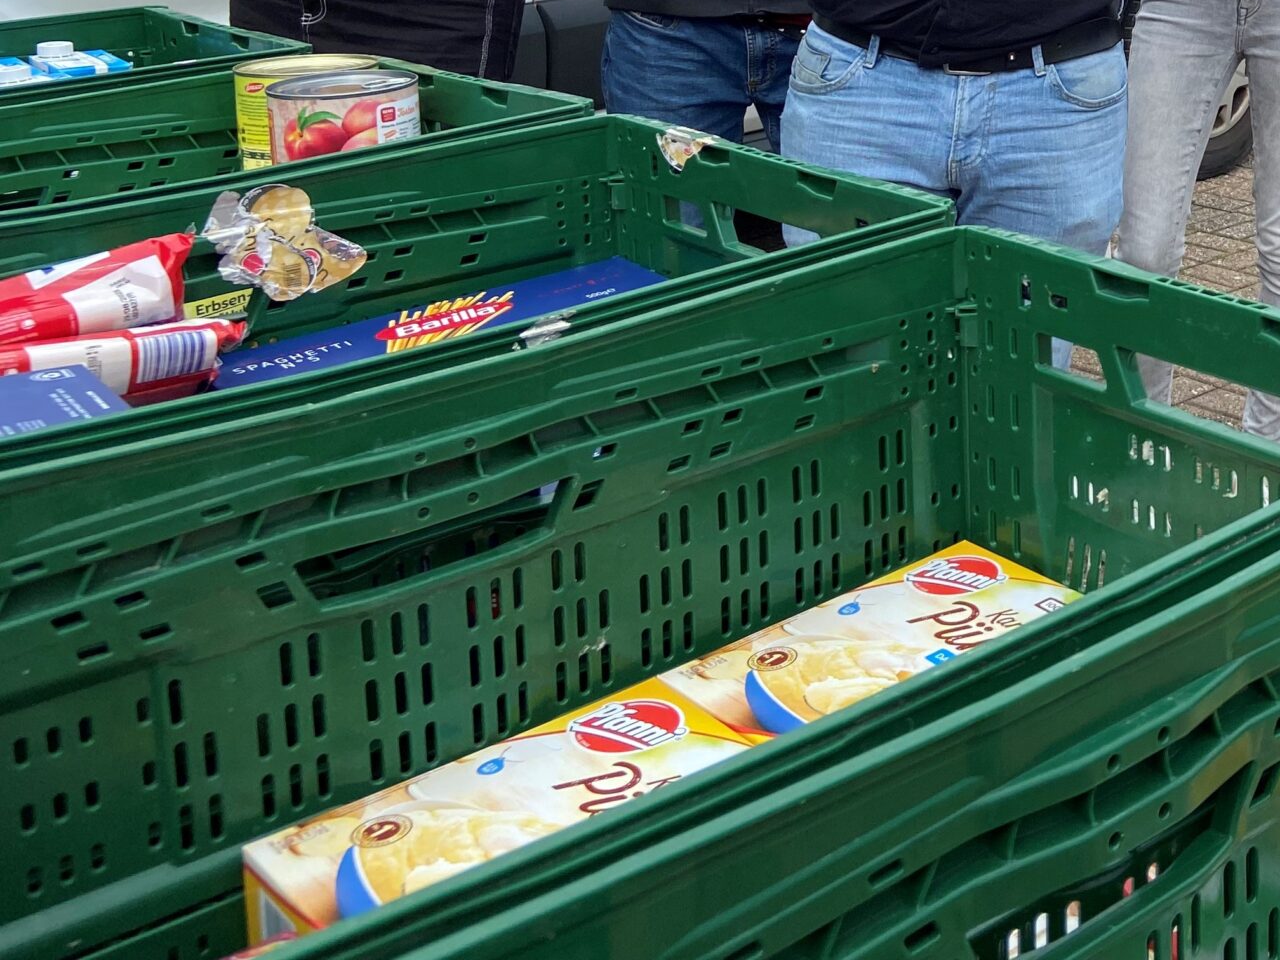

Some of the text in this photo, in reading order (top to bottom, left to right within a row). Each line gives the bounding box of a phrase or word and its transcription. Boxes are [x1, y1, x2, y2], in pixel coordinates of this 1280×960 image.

[395, 305, 497, 337] Barilla
[232, 340, 353, 375] SPAGHETTI
[907, 559, 1007, 590] Pfanni
[571, 703, 688, 747] Pfanni
